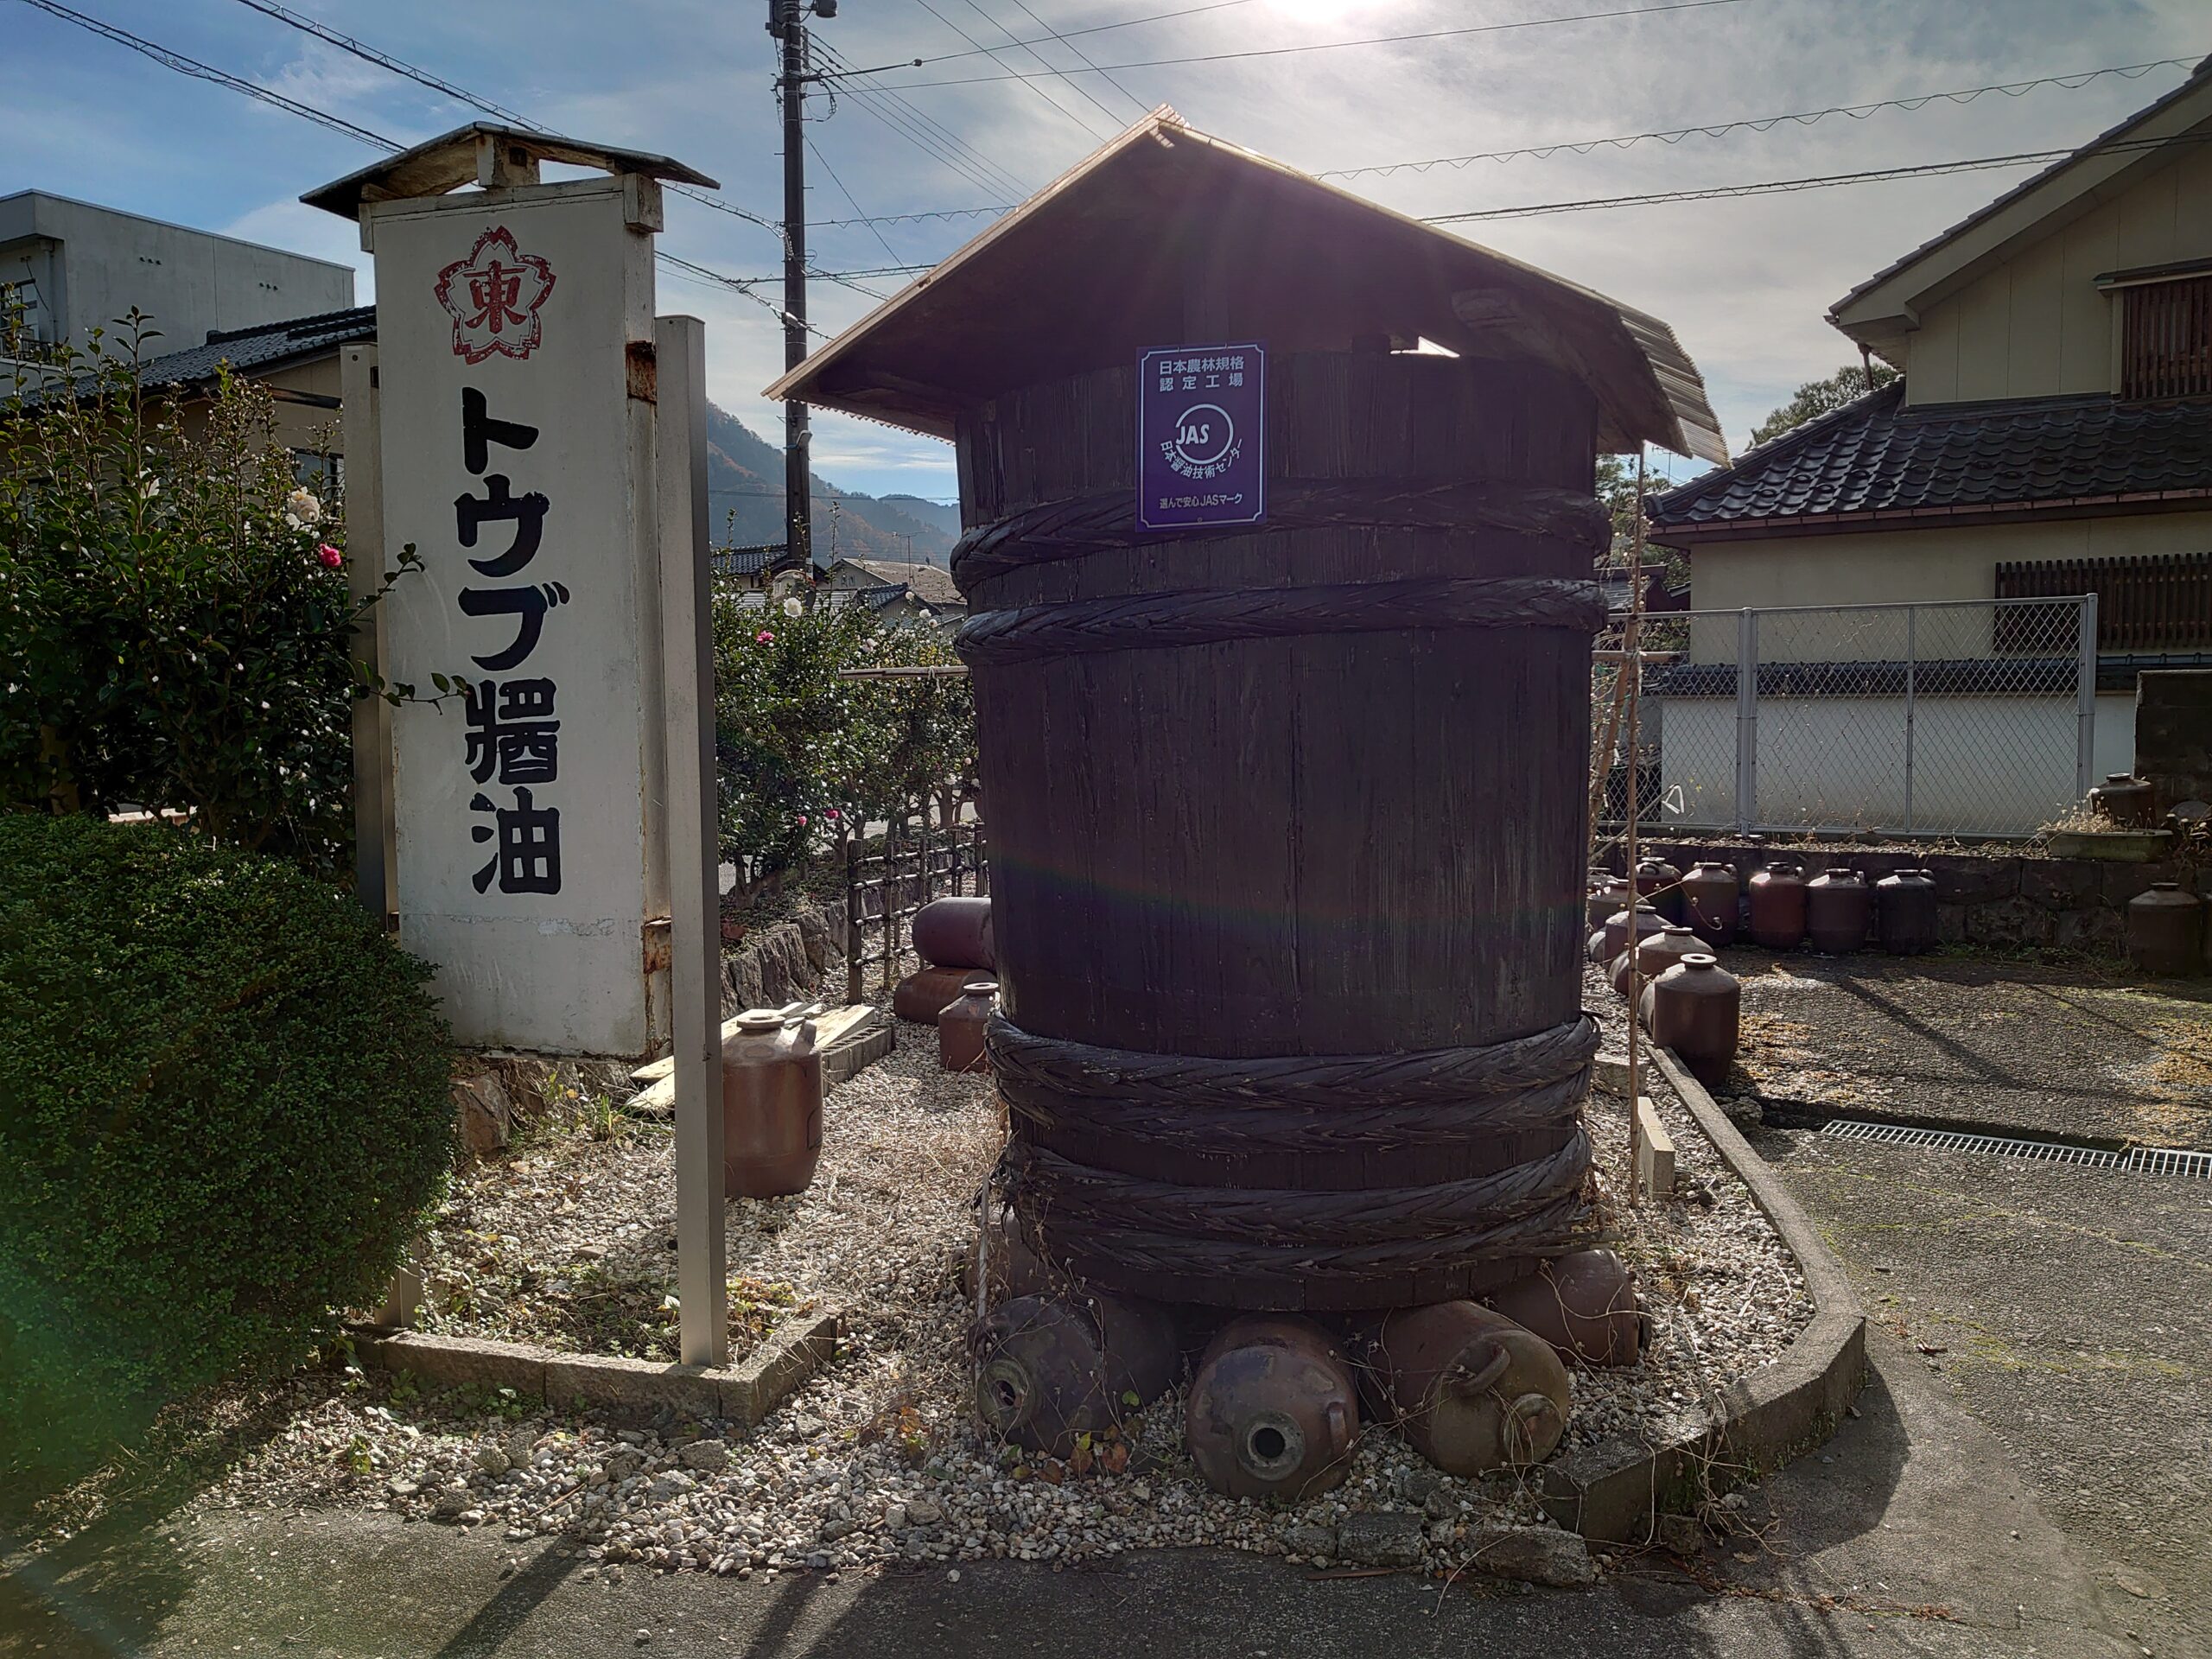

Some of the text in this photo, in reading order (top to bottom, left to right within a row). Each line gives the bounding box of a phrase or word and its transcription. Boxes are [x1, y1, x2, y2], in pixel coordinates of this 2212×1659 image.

[464, 260, 527, 334] 東
[1159, 355, 1244, 375] 日本農林規格
[1176, 423, 1210, 445] JAS
